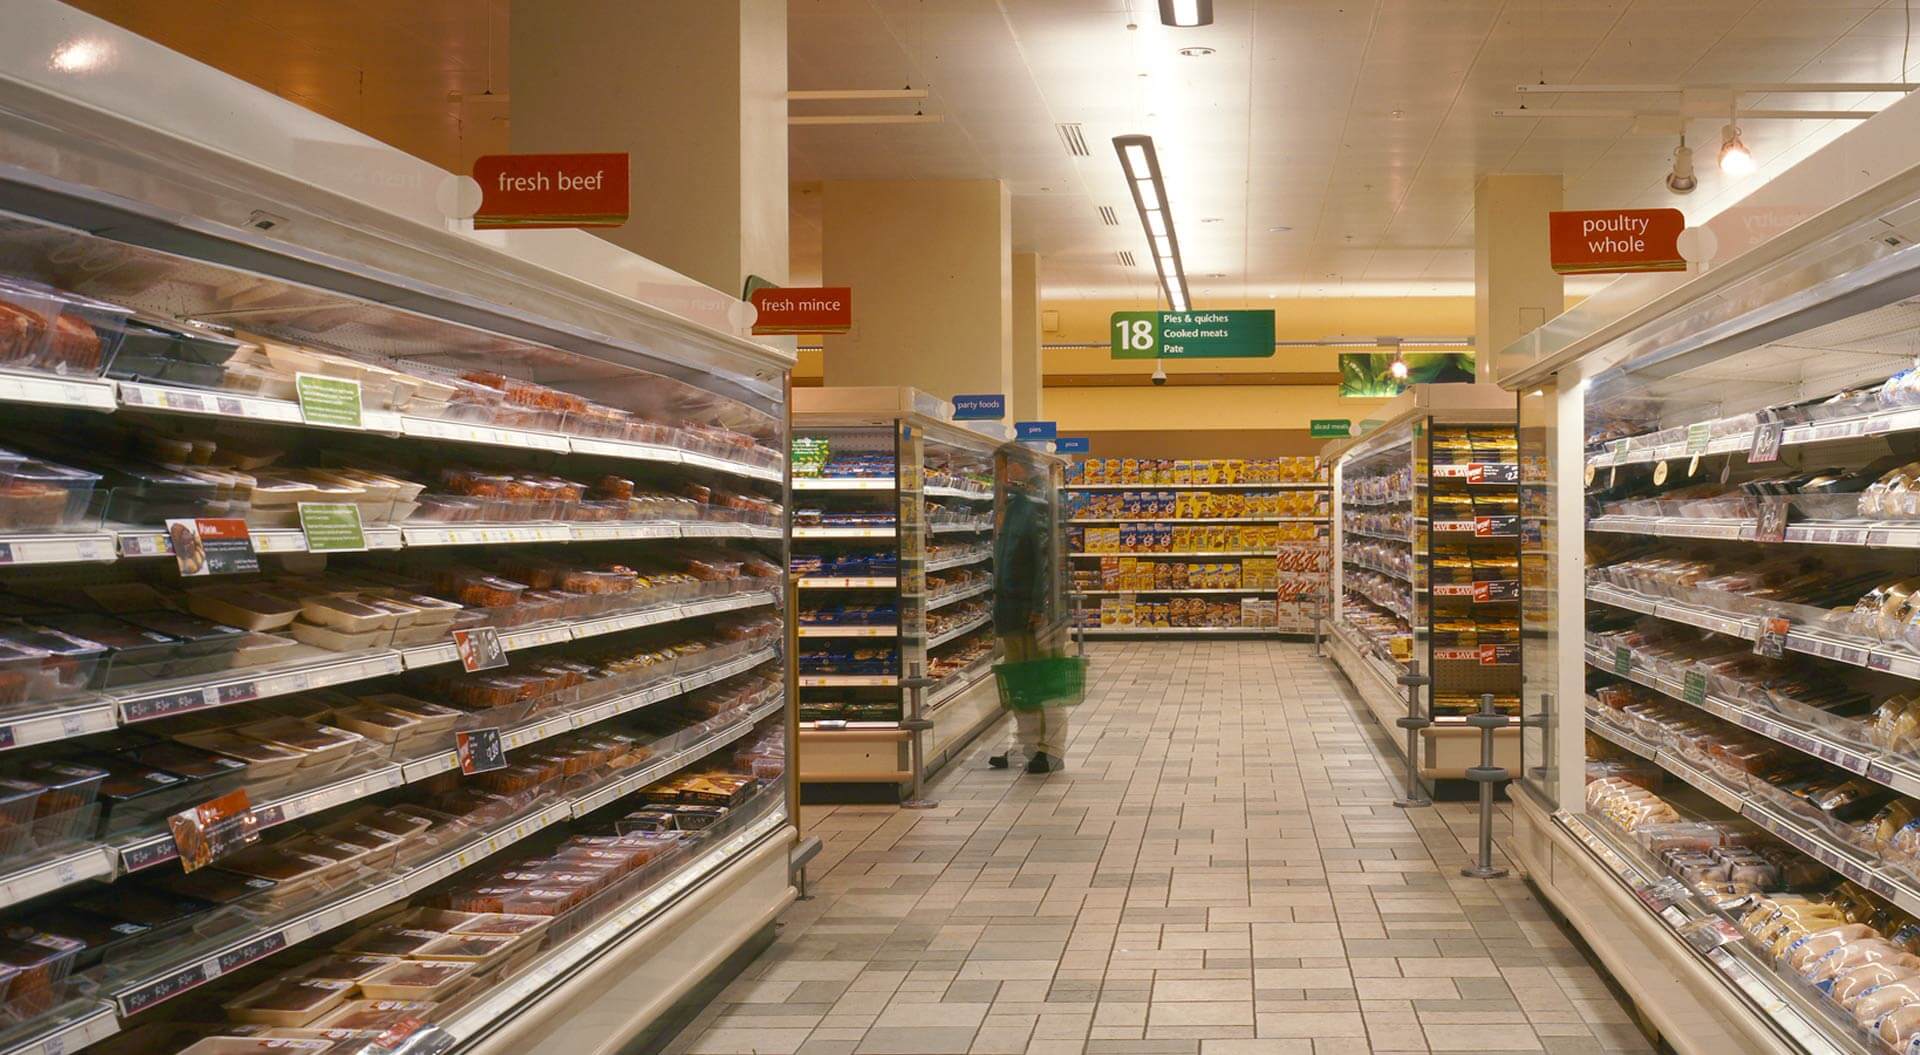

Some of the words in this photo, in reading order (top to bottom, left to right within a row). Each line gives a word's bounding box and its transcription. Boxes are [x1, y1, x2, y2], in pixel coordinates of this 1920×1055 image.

[498, 171, 550, 191] fresh
[558, 170, 604, 190] beef
[1583, 214, 1649, 236] poultry
[1588, 236, 1645, 253] whole
[761, 299, 794, 312] fresh
[799, 298, 841, 312] mince
[1163, 314, 1182, 323] Pies
[1184, 314, 1192, 323] &
[1194, 314, 1229, 325] quiches
[1115, 320, 1154, 350] 18
[1163, 329, 1199, 338] Cooked
[1200, 330, 1228, 338] meats
[1163, 344, 1184, 353] Pate
[957, 401, 978, 410] party
[979, 400, 1000, 408] foods
